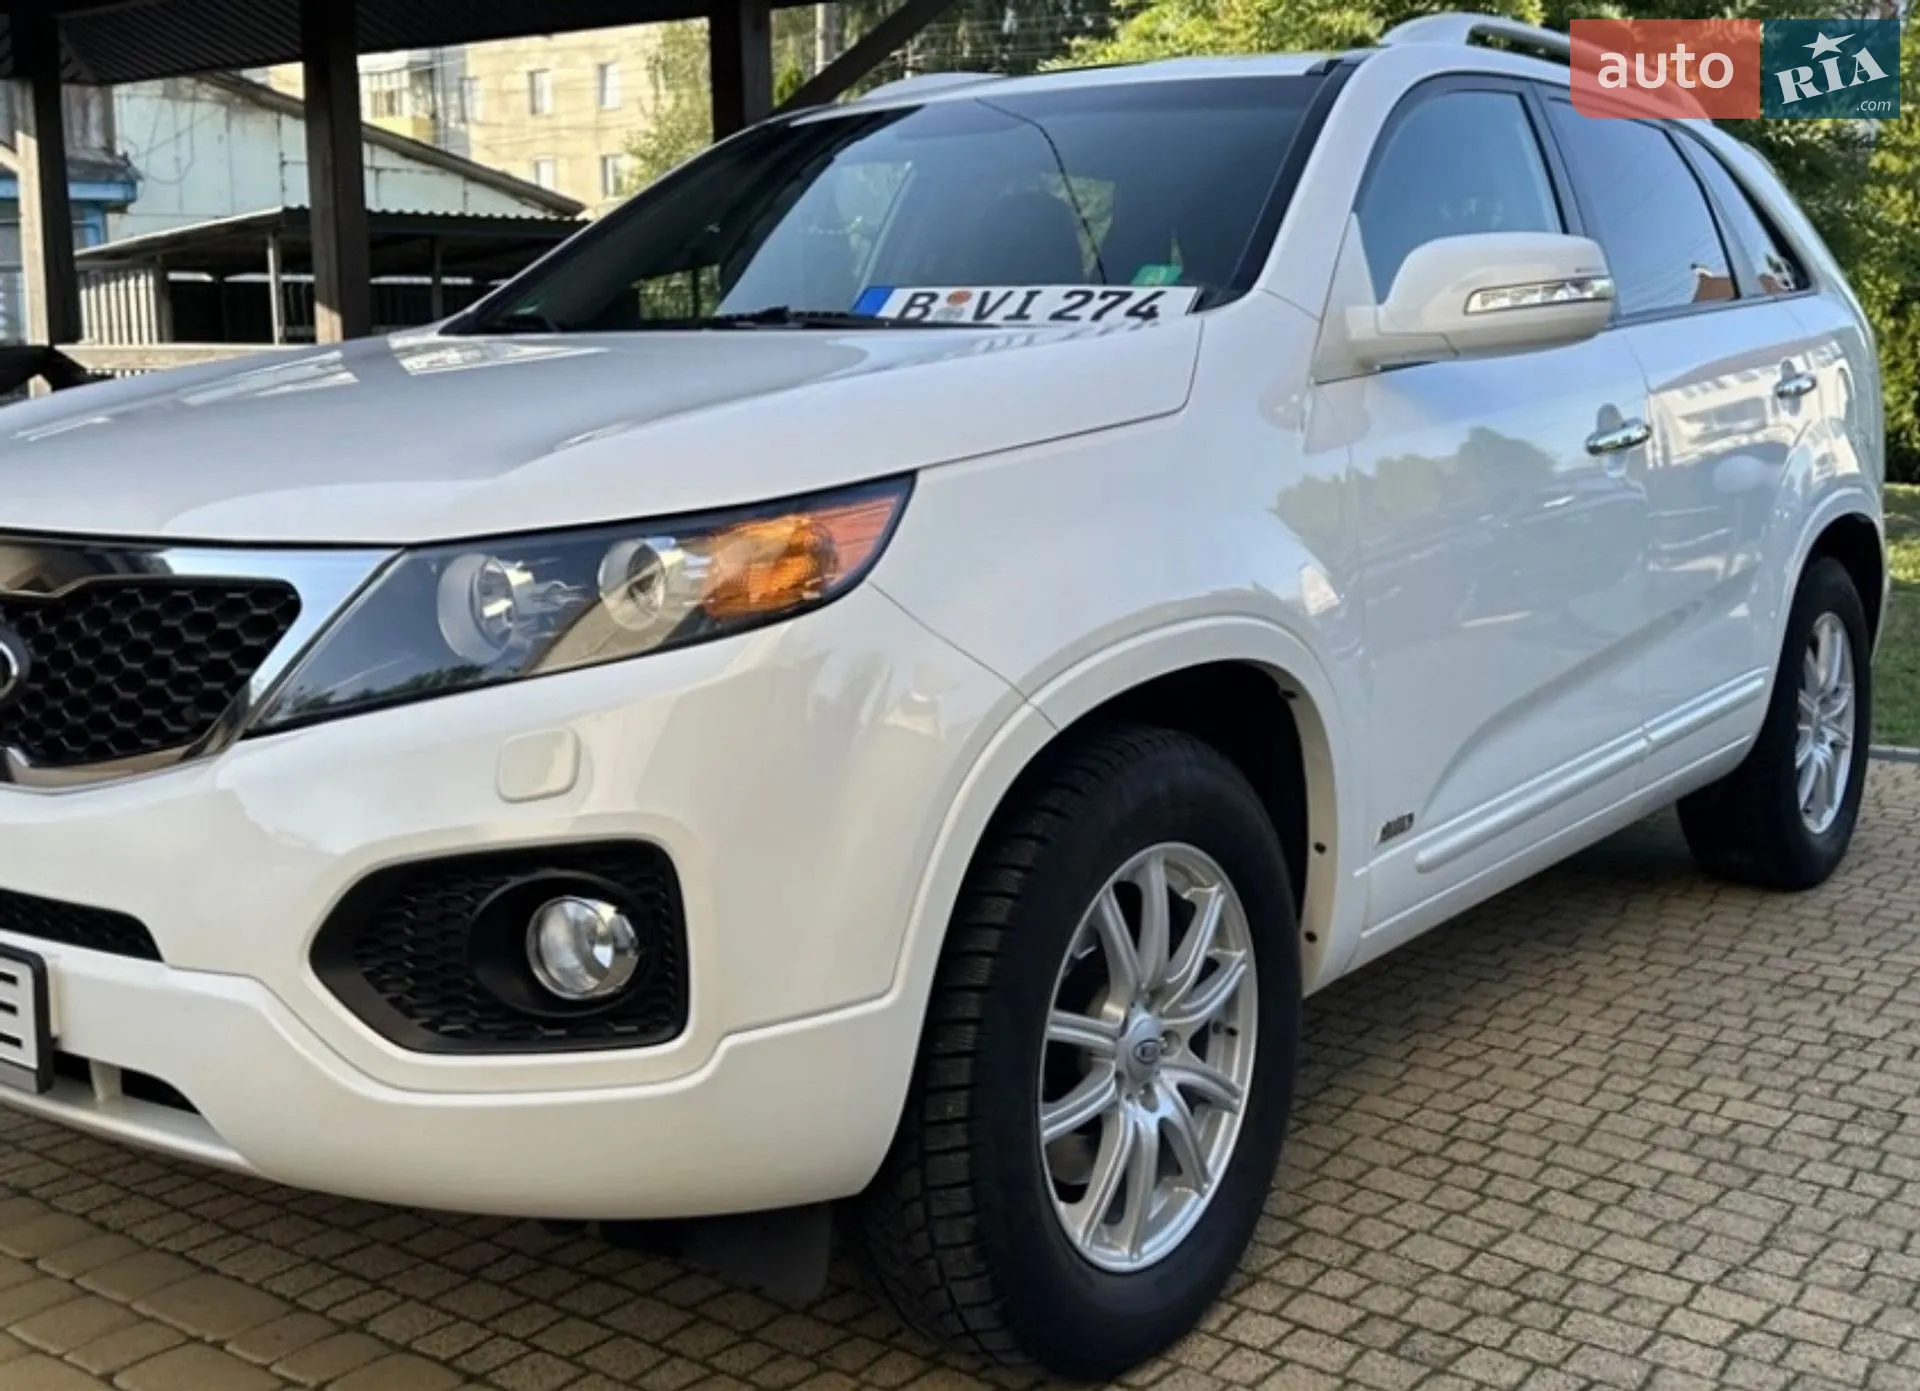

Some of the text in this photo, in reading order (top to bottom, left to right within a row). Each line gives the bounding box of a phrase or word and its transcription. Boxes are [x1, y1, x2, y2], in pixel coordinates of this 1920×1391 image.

[898, 290, 1167, 321] B VI 274
